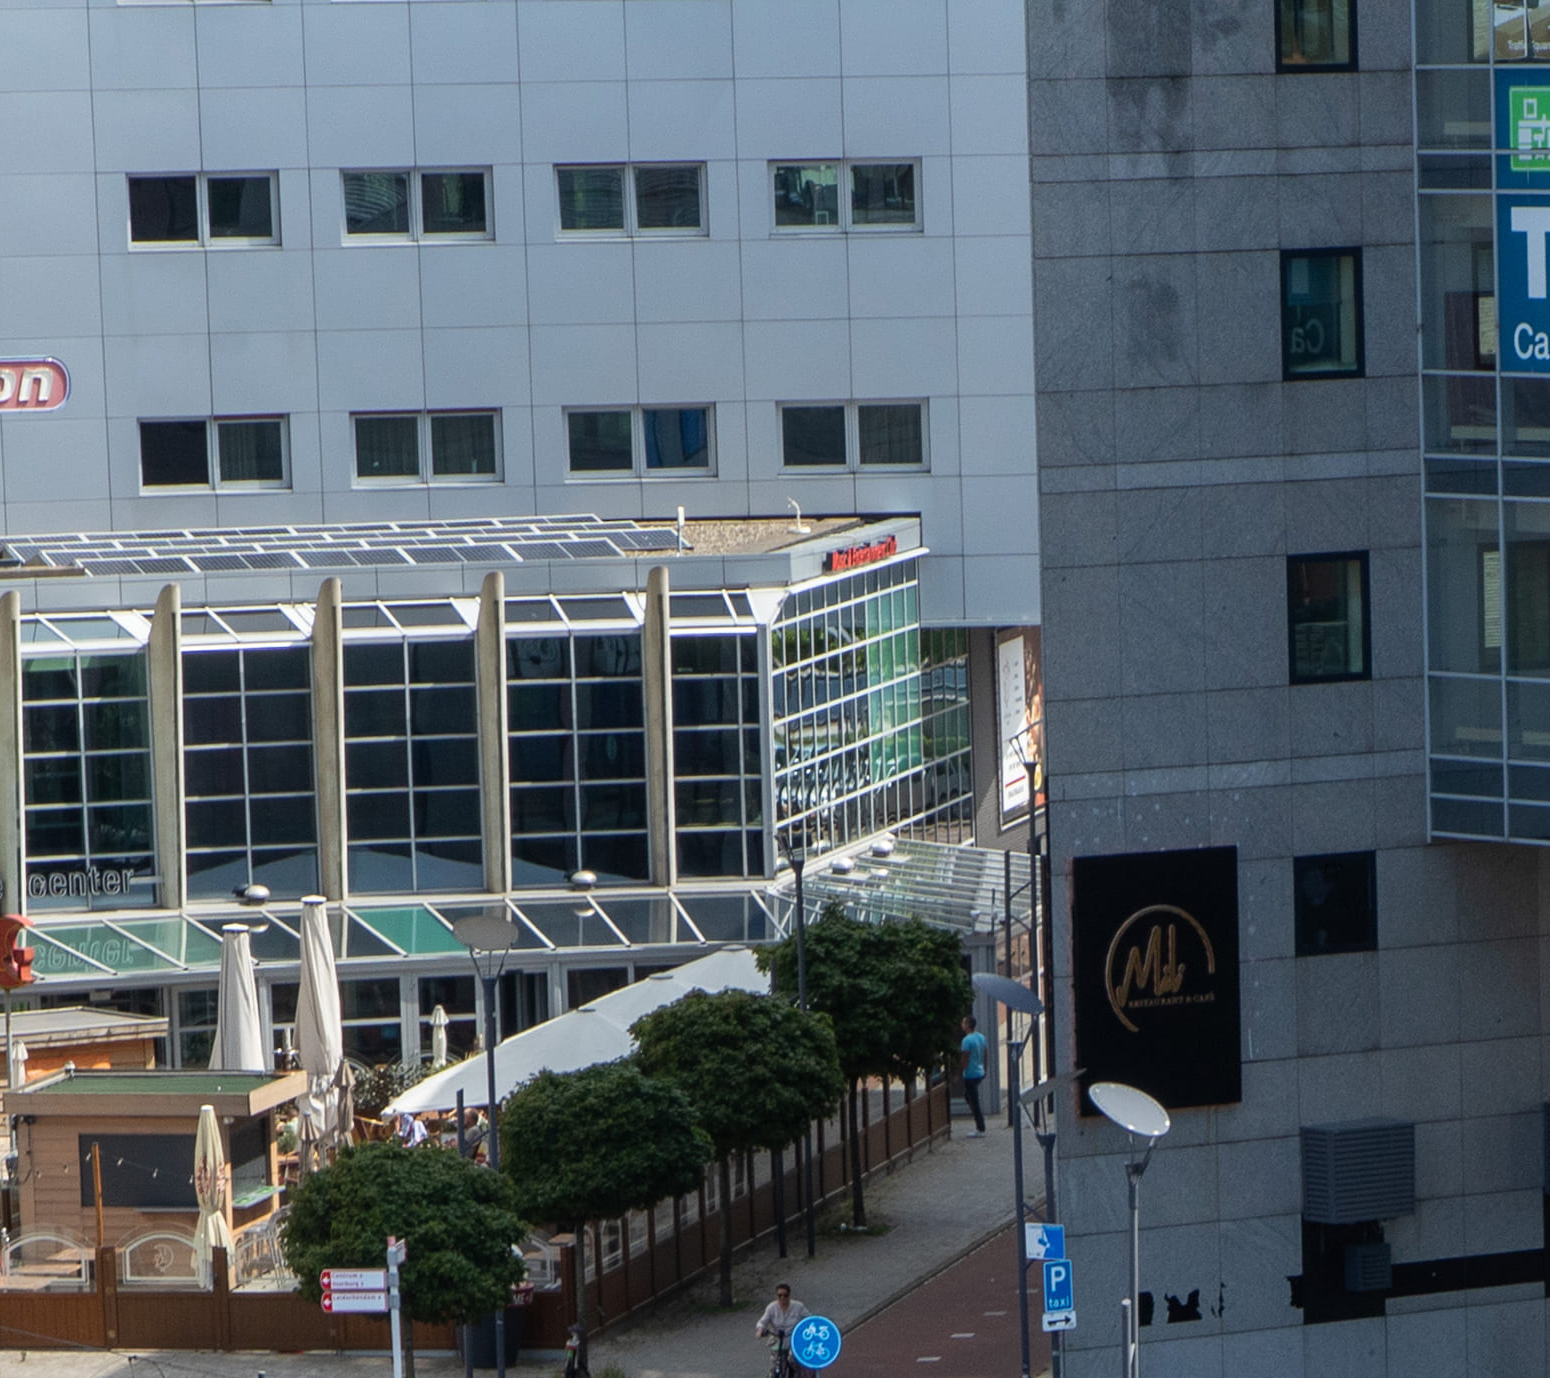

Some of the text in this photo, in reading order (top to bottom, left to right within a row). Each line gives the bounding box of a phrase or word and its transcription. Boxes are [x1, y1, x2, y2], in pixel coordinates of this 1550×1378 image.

[28, 866, 134, 897] center
[1051, 1266, 1066, 1292] P
[1049, 1296, 1069, 1309] taxi
